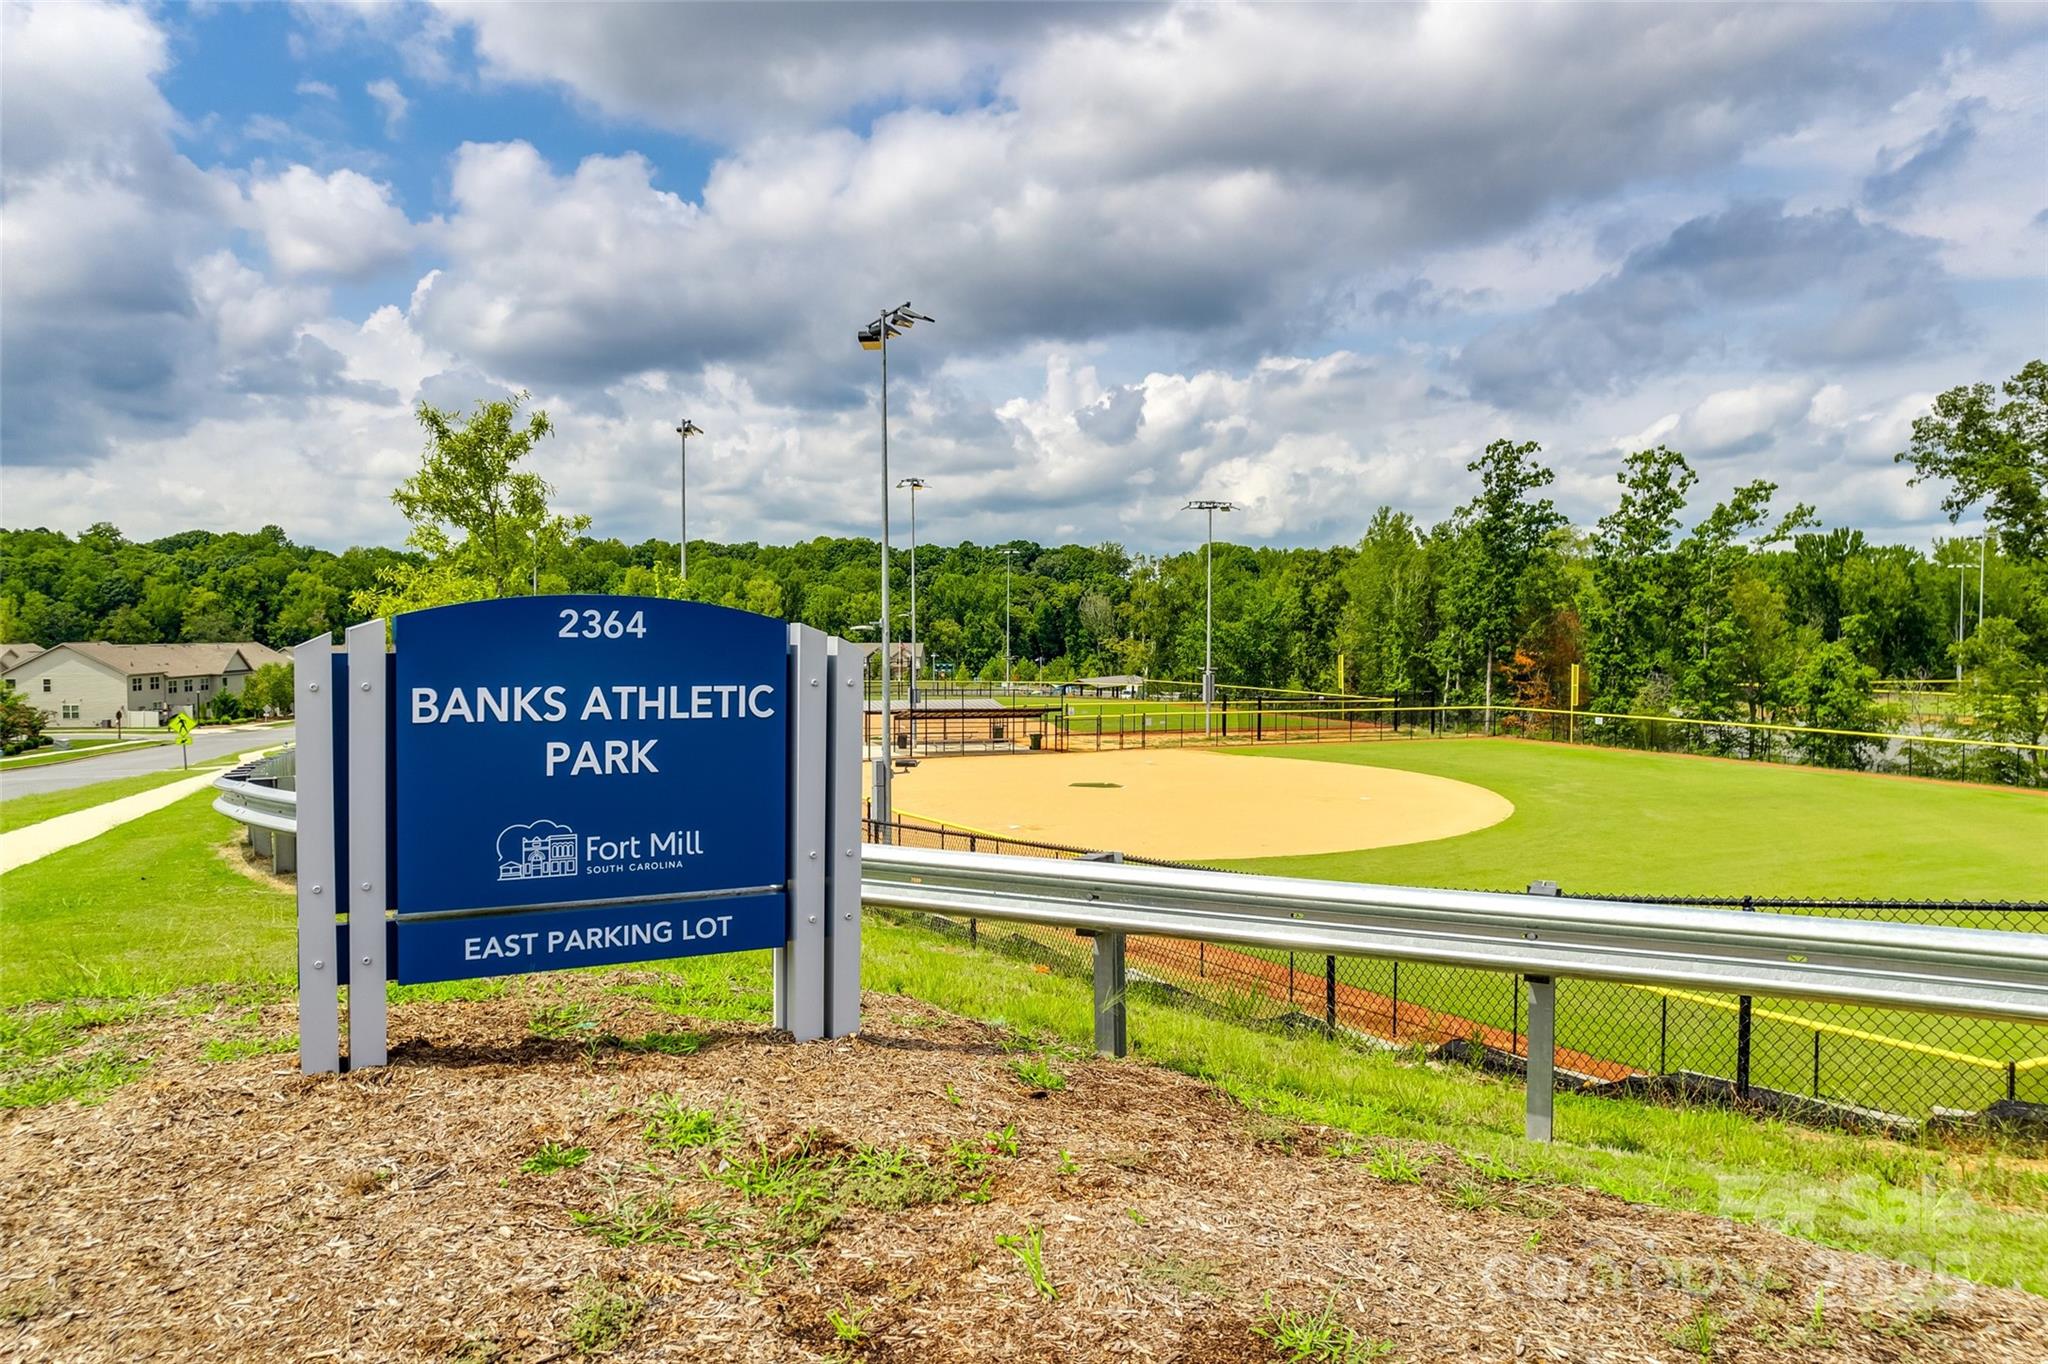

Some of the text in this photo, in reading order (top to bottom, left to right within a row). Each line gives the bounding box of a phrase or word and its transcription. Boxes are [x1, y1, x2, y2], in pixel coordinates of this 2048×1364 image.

[559, 609, 646, 638] 2364
[412, 685, 774, 723] BANKS ATHLETIC
[547, 740, 658, 776] PARK
[587, 831, 703, 861] Fort Mill
[587, 861, 682, 874] SOUTH CAROLINA
[465, 916, 732, 960] EAST PARKING LOT
